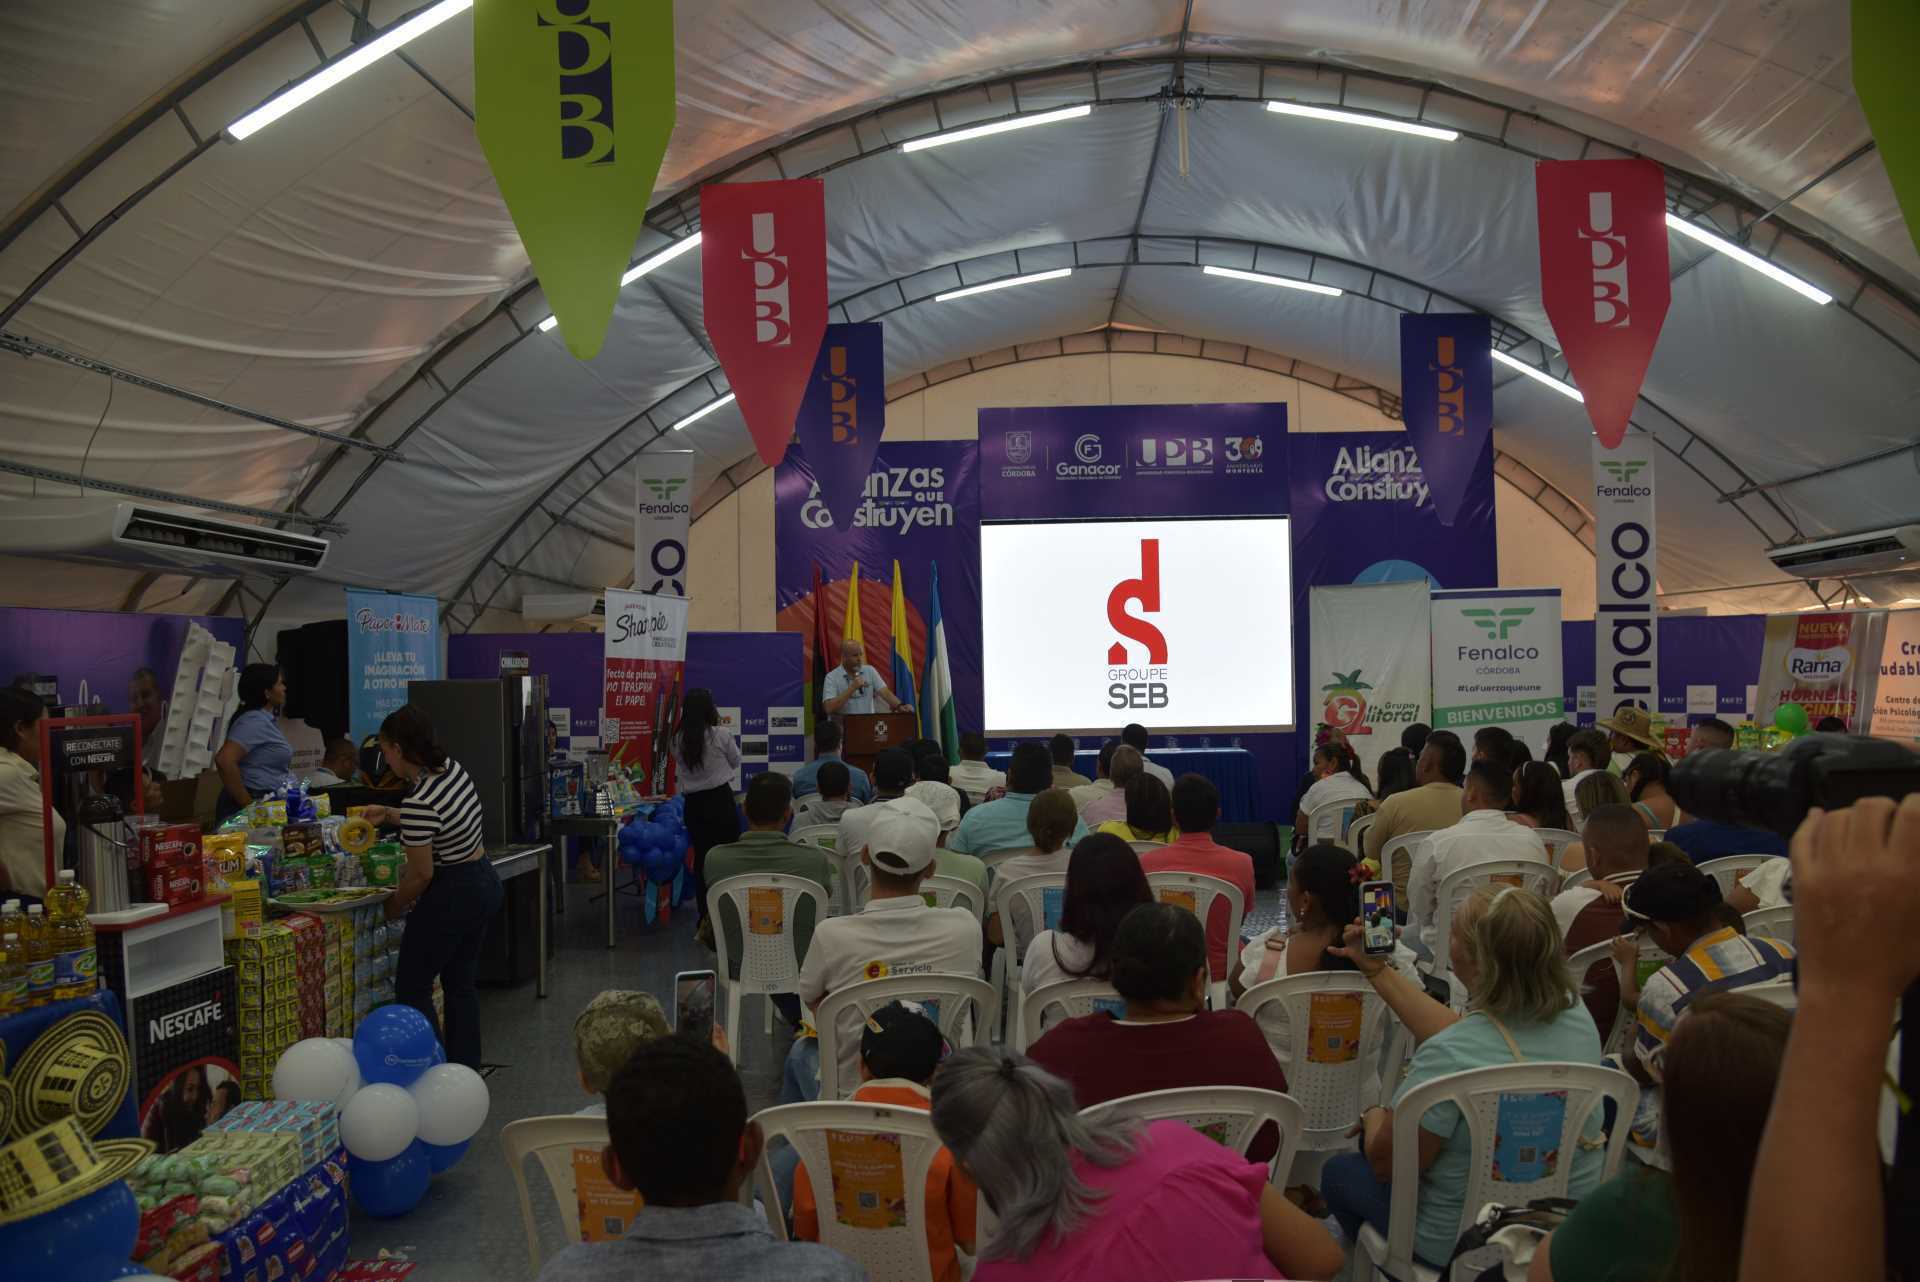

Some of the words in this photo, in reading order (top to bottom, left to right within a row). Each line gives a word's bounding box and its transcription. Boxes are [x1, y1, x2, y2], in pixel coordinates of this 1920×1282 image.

[1578, 192, 1631, 328] UPB
[741, 212, 791, 347] UPB
[821, 346, 858, 445] UPB
[1428, 336, 1465, 437] UPB
[1136, 438, 1213, 466] UPB
[1056, 462, 1121, 476] Ganacor
[914, 491, 944, 502] QUE
[1325, 474, 1430, 507] Construy
[1597, 485, 1651, 498] Fenalco
[639, 502, 689, 514] Fenalco
[800, 499, 953, 536] Costruyen
[1599, 522, 1651, 717] nalco
[1458, 645, 1538, 660] Fenalco
[1108, 668, 1168, 681] GROUPE
[1792, 658, 1842, 674] Rama
[1107, 682, 1168, 710] SEB
[1384, 702, 1415, 711] Grupo
[1366, 704, 1420, 722] litoral
[1447, 702, 1557, 724] BIENVENIDOS
